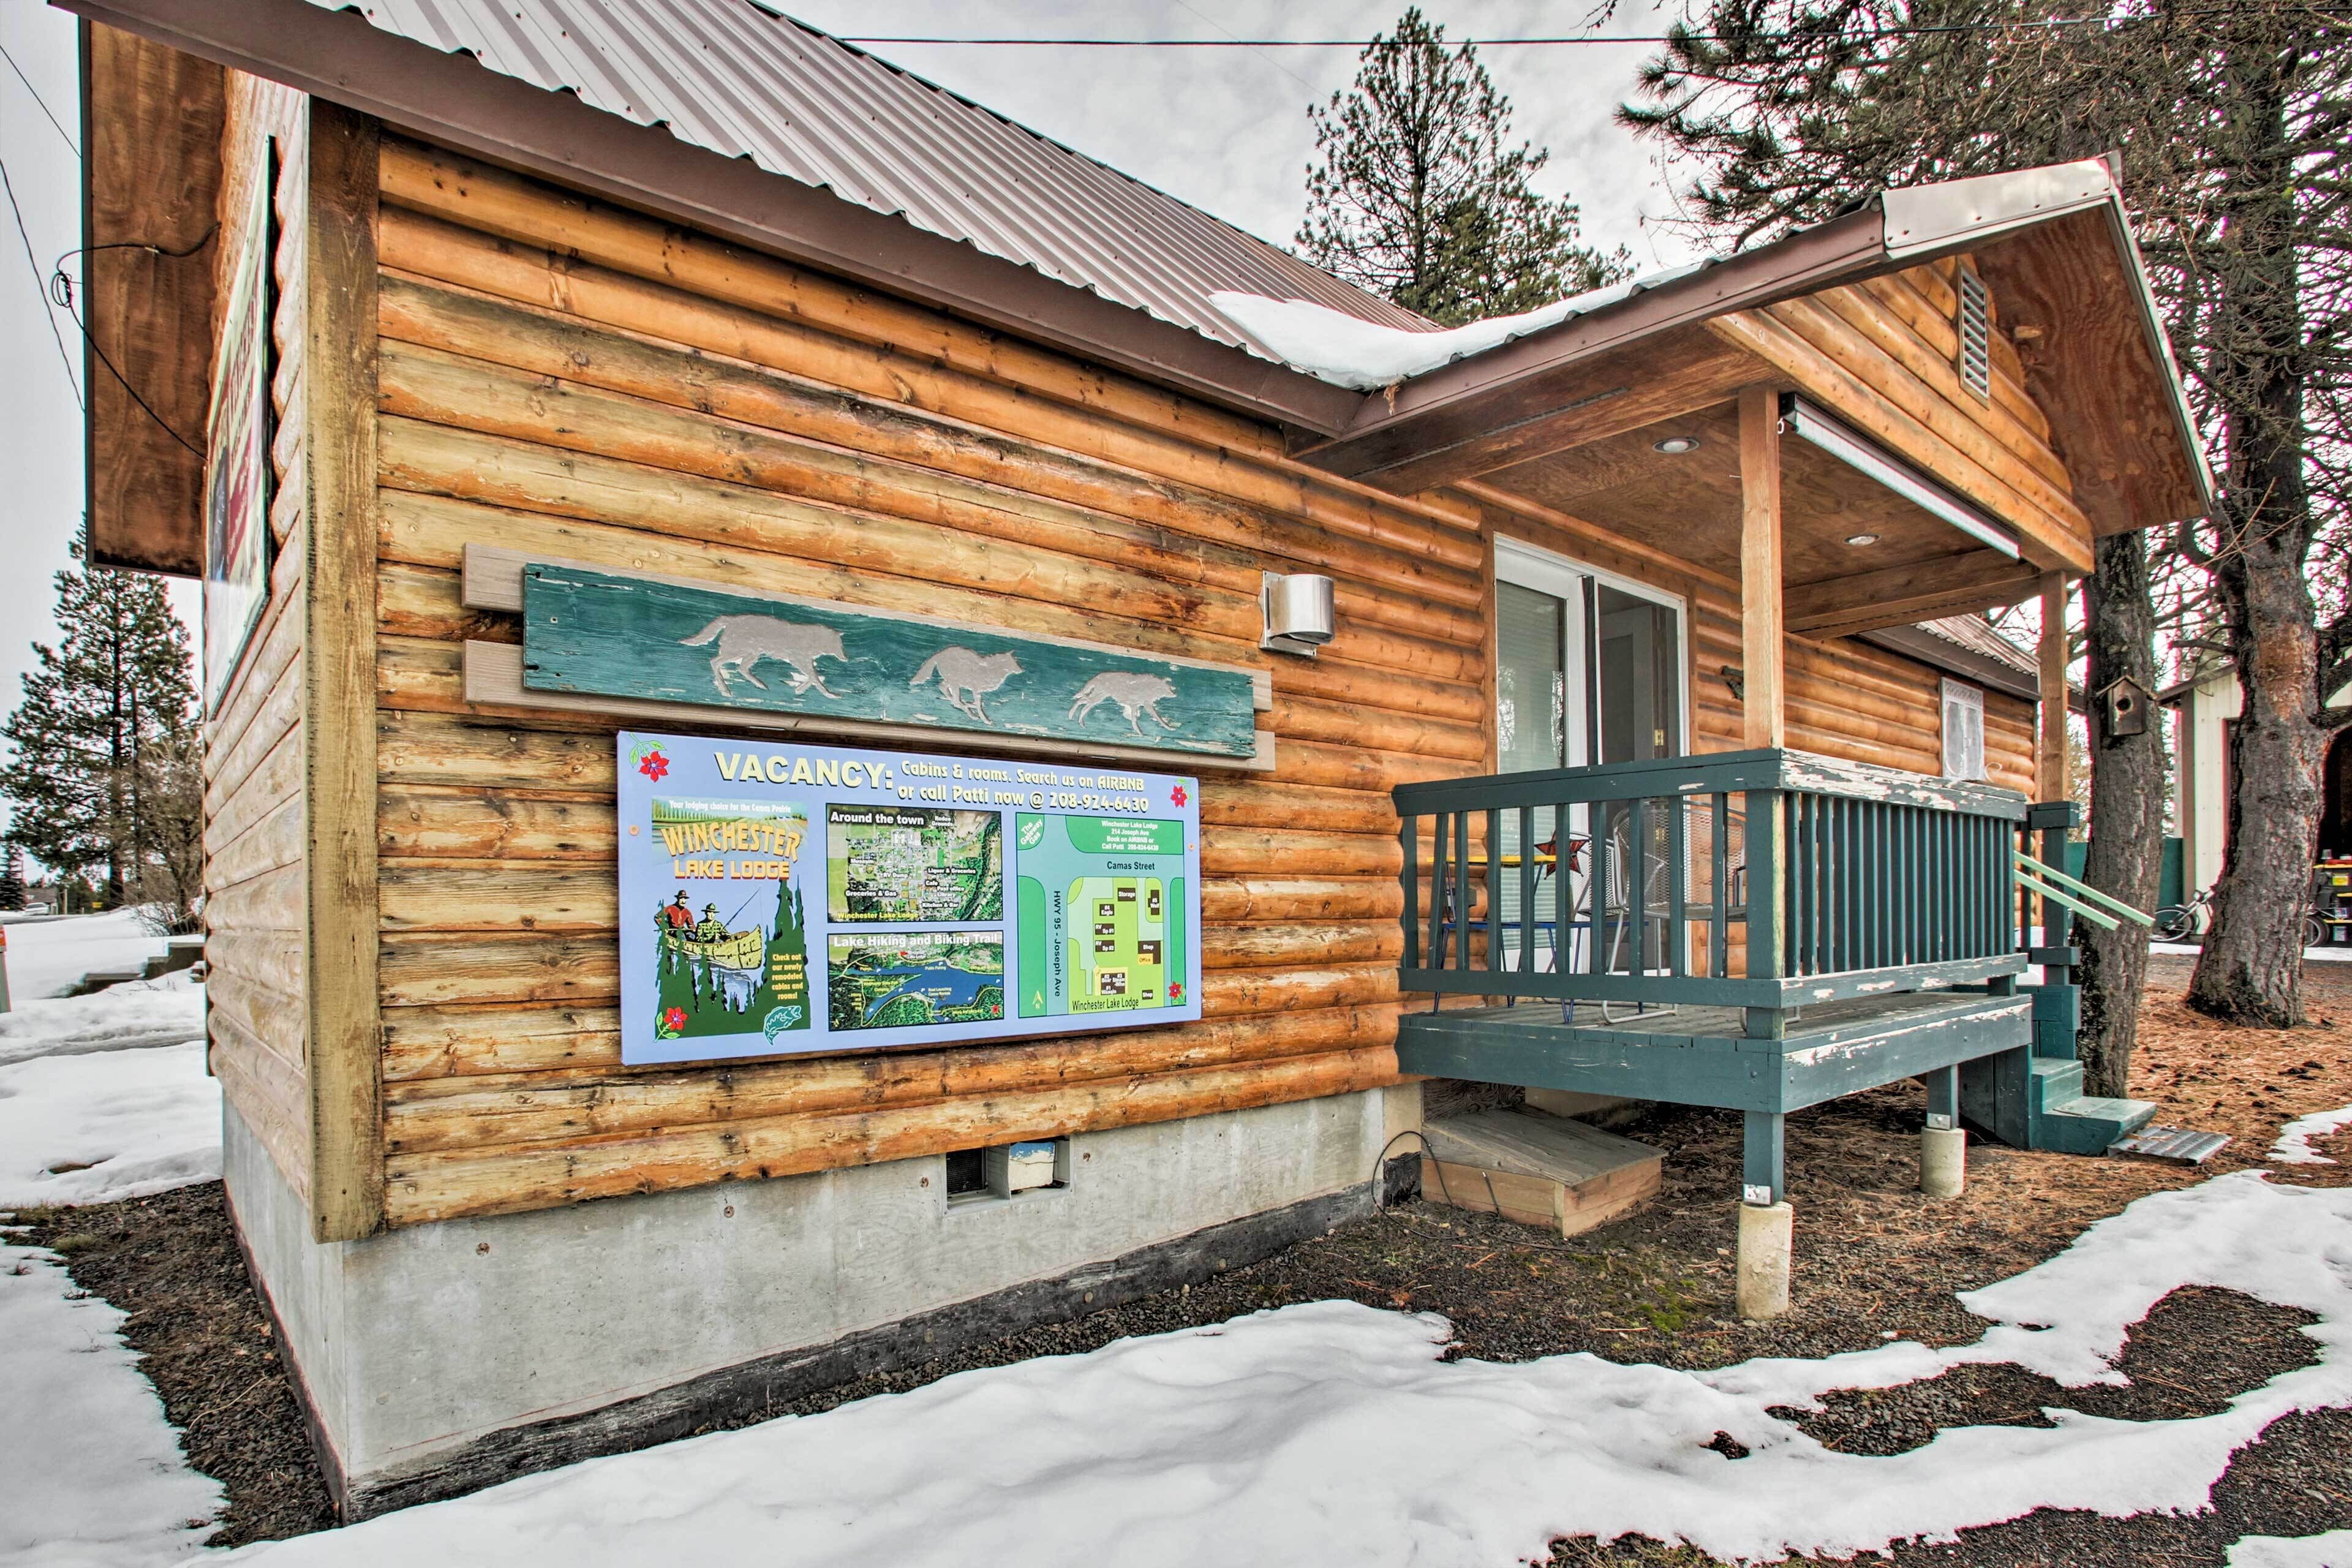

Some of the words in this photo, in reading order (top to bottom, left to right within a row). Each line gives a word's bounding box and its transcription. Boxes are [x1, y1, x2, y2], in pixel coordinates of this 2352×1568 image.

[714, 752, 893, 790] VACANCY:
[901, 760, 948, 778] Cabins
[952, 764, 963, 779] &
[968, 767, 1011, 783] rooms.
[1016, 769, 1057, 786] Search
[1061, 774, 1076, 788] us
[1079, 775, 1093, 789] on
[1097, 775, 1144, 792] AIRBNB
[897, 786, 914, 800] or
[920, 785, 946, 801] call
[952, 785, 989, 804] Patti
[994, 791, 1024, 806] now
[1029, 792, 1044, 810] @
[1050, 791, 1150, 813] 208-924-6430
[669, 800, 684, 810] Your
[685, 801, 708, 812] lodging
[710, 802, 728, 810] choice
[729, 802, 739, 811] for
[741, 803, 750, 812] the
[772, 804, 791, 813] Prairie
[831, 812, 872, 823] Around
[875, 813, 894, 824] the
[896, 815, 924, 825] town
[1020, 819, 1043, 845] Gateway
[1021, 822, 1033, 834] The
[661, 821, 801, 864] WINCHESTER
[1029, 832, 1041, 845] Gas
[674, 859, 724, 880] LAKE
[731, 860, 790, 880] LODGE
[1107, 861, 1132, 870] Camas
[1134, 861, 1155, 870] Street
[1054, 918, 1061, 930] 95
[834, 936, 864, 947] Lake
[867, 935, 907, 948] Hiking
[908, 934, 931, 944] and
[935, 934, 970, 946] Biking
[974, 933, 997, 943] Trail
[784, 963, 802, 971] newly
[1072, 1000, 1106, 1011] Winchester
[1107, 998, 1120, 1009] Lake
[1121, 997, 1139, 1010] Lodge
